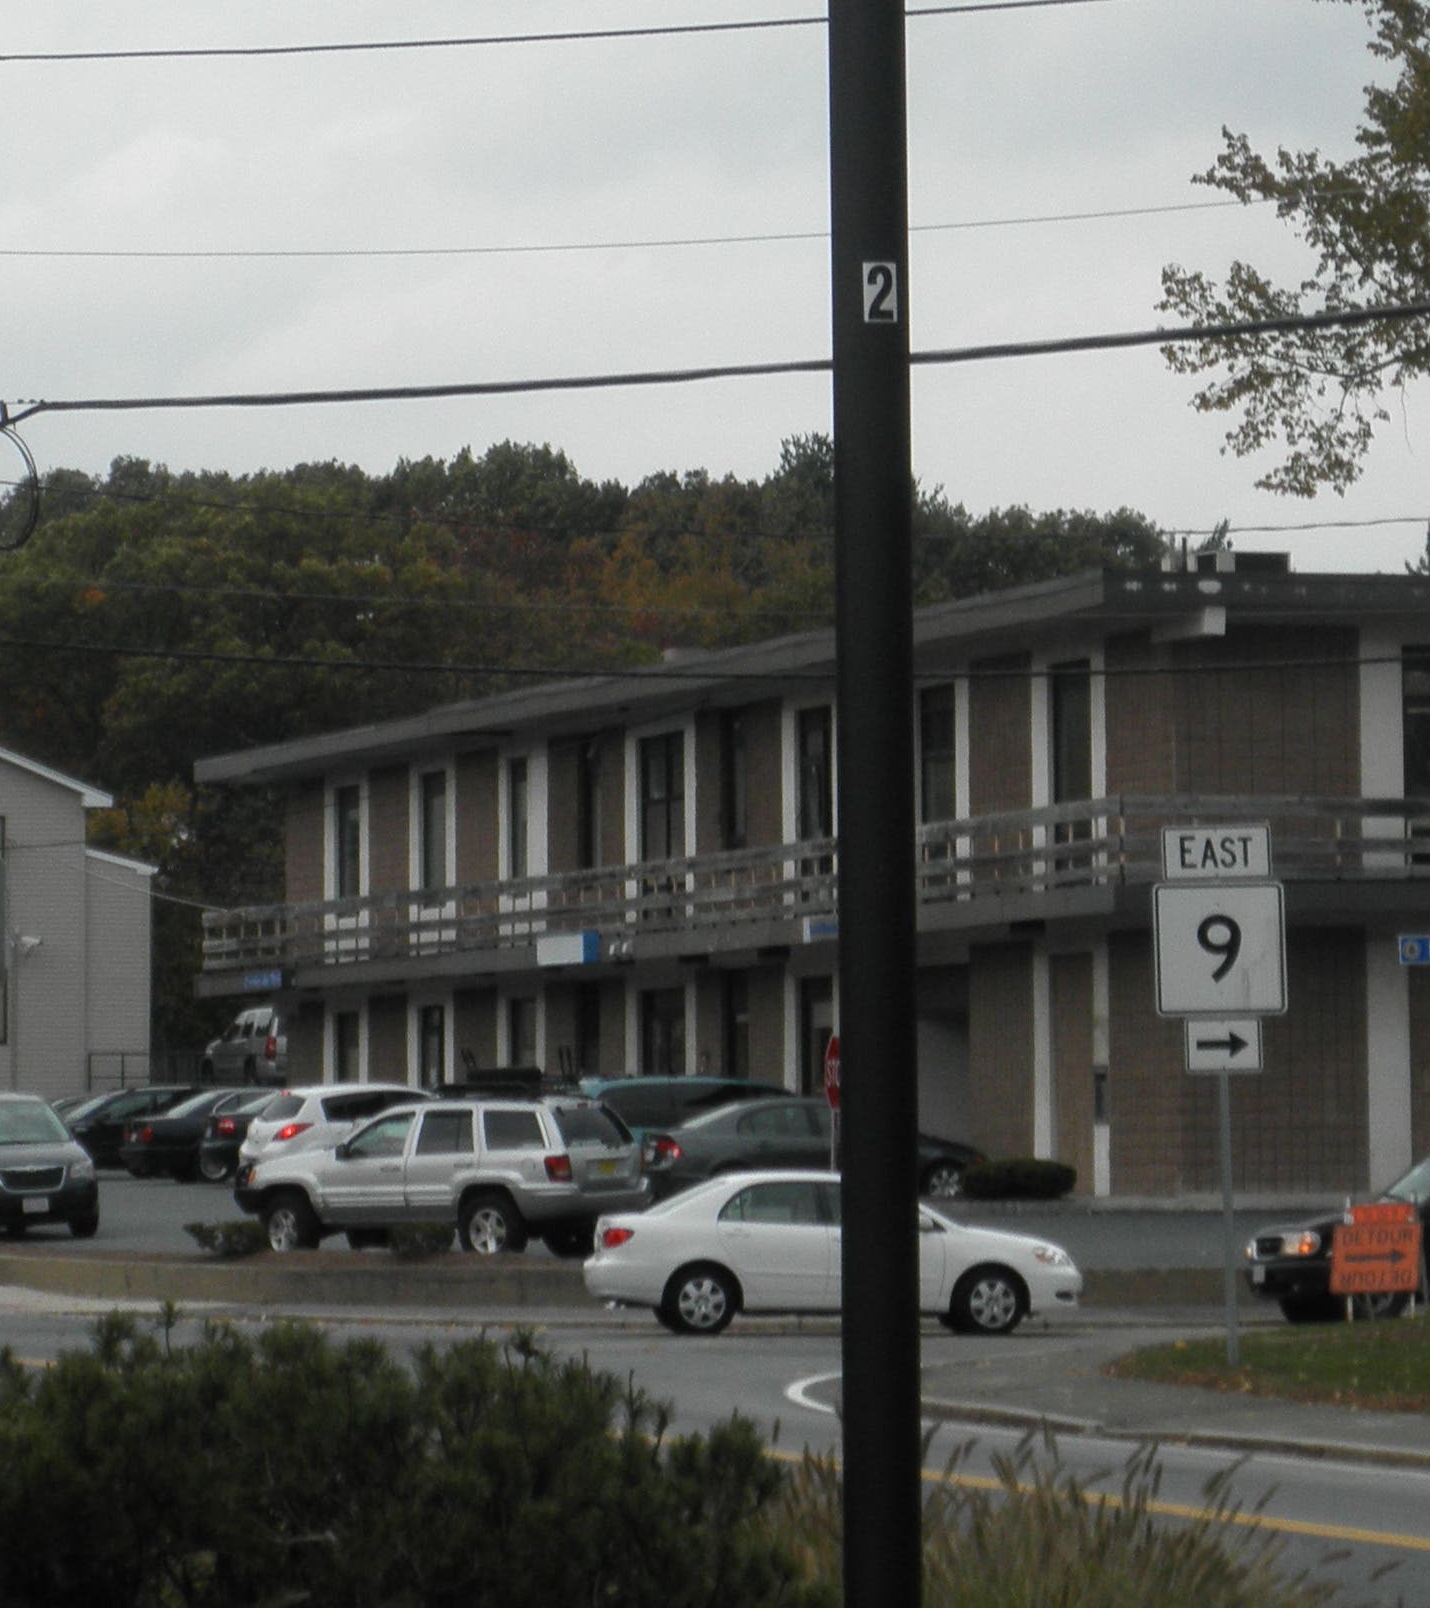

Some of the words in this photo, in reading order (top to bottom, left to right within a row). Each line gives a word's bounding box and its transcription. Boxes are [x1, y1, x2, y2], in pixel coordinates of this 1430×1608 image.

[867, 264, 894, 320] 2
[1179, 836, 1252, 869] EAST
[1197, 914, 1242, 984] 9
[1341, 1228, 1412, 1246] DETOUR
